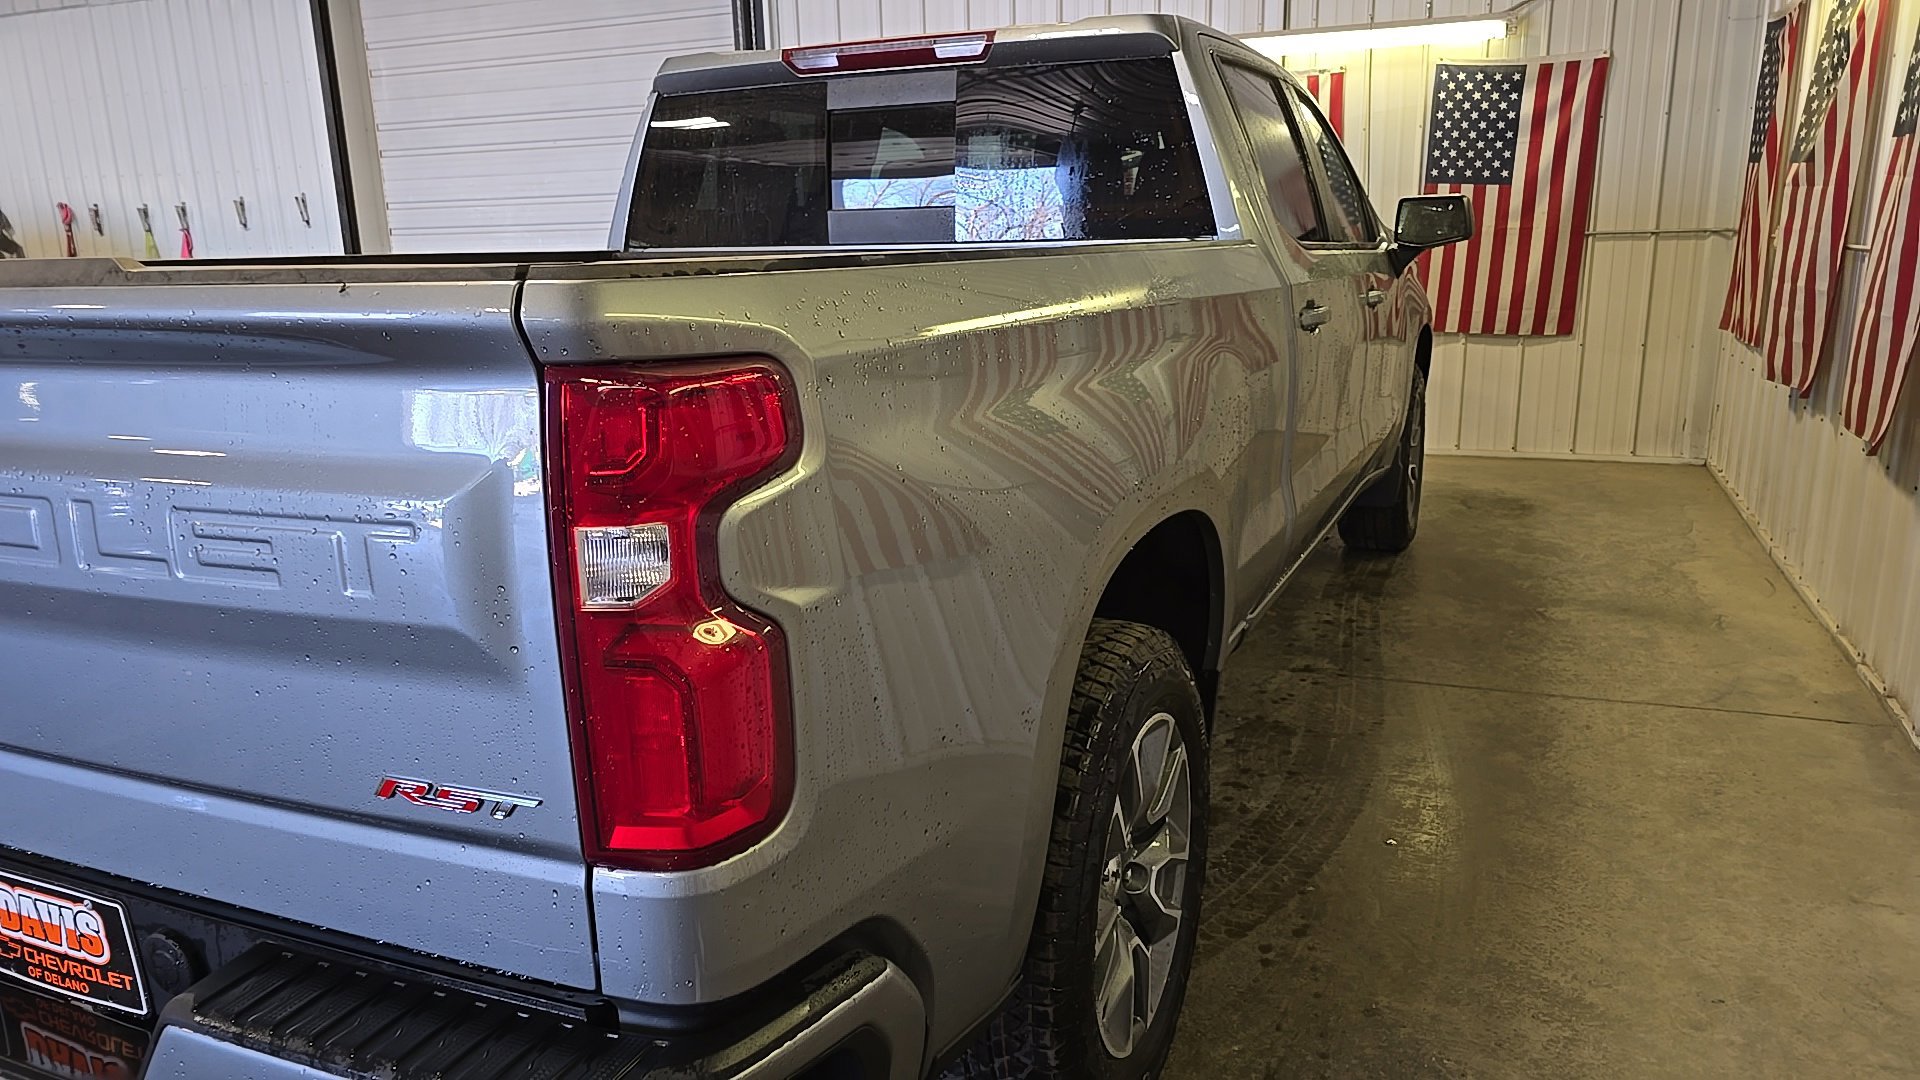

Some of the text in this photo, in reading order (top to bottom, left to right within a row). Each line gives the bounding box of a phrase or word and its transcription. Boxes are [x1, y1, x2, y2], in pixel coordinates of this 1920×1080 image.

[375, 775, 543, 819] RST
[0, 887, 106, 957] DAVIS
[24, 947, 133, 991] CHEVROLET
[28, 965, 90, 994] OF DELANO
